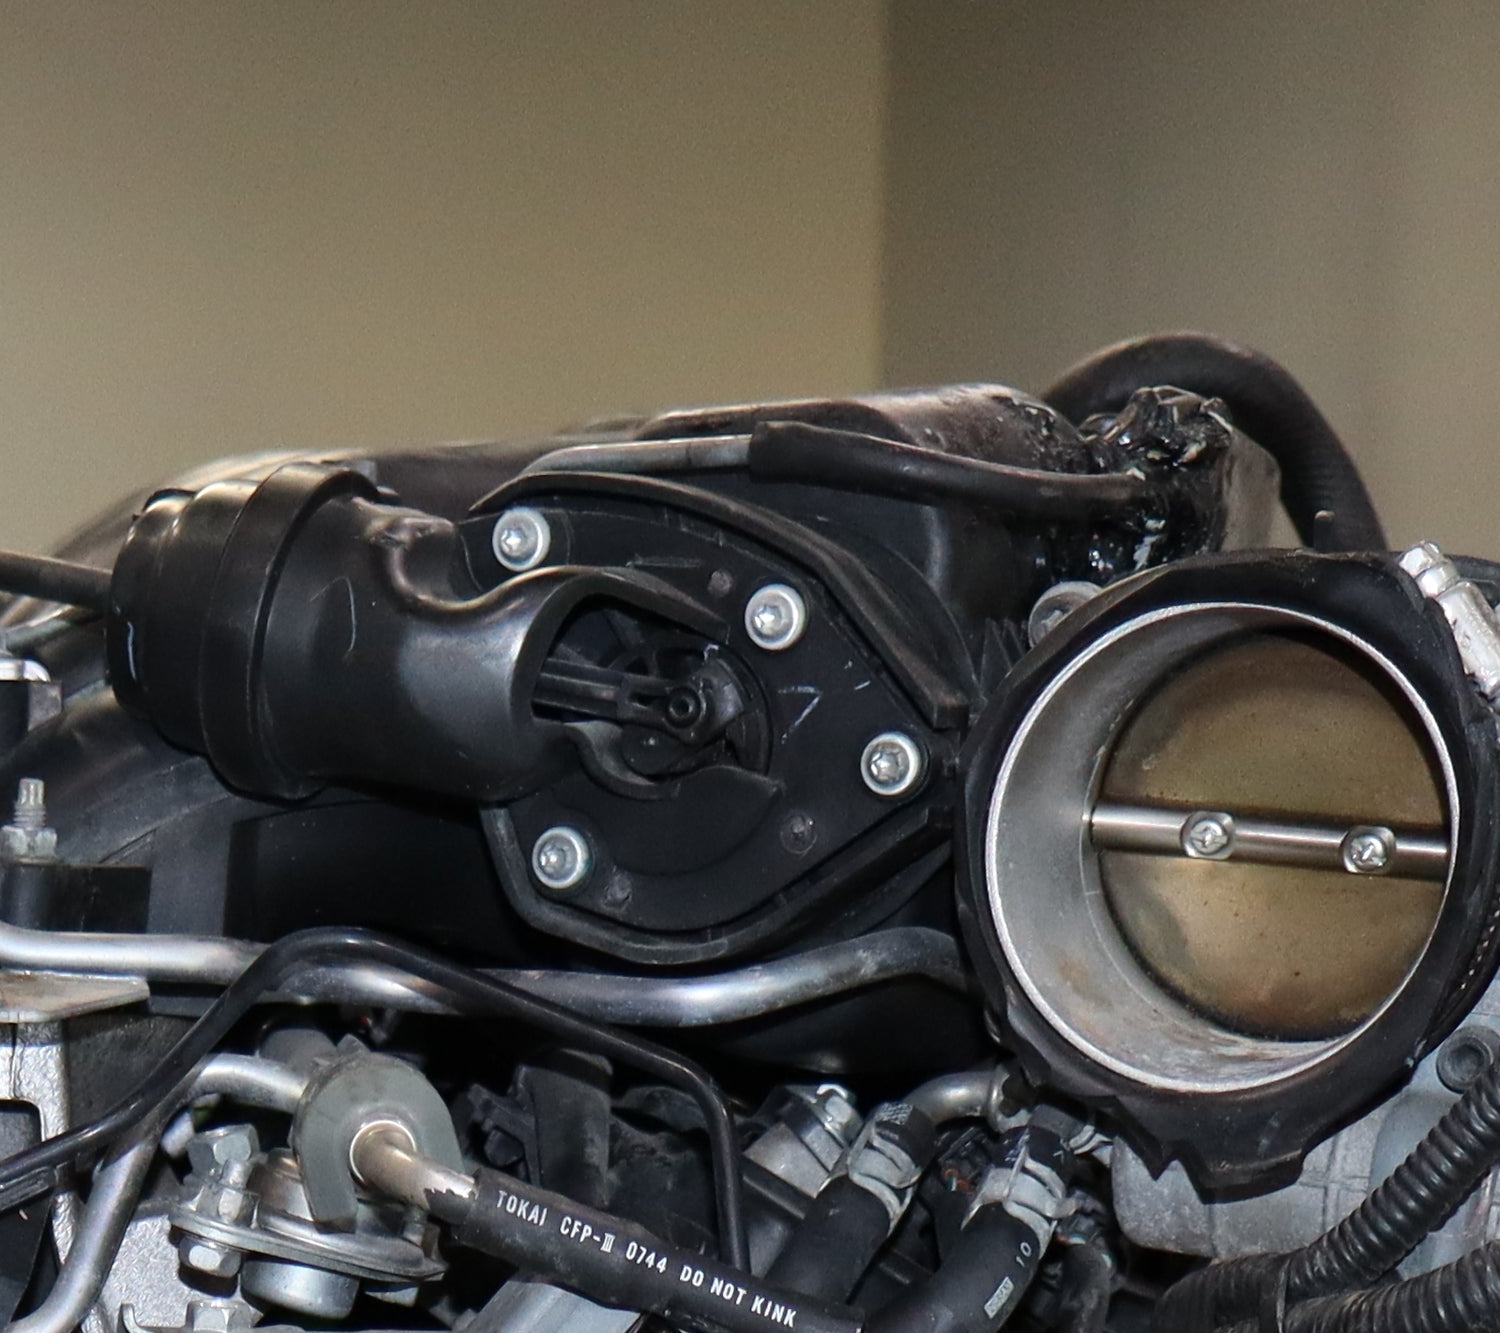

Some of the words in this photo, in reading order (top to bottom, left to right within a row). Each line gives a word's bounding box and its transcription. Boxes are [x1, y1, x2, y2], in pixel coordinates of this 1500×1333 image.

[495, 1189, 549, 1228] TOKAI
[625, 1241, 668, 1275] 0744
[679, 1264, 706, 1289] DO
[710, 1278, 749, 1307] NOT
[750, 1295, 798, 1328] KINK
